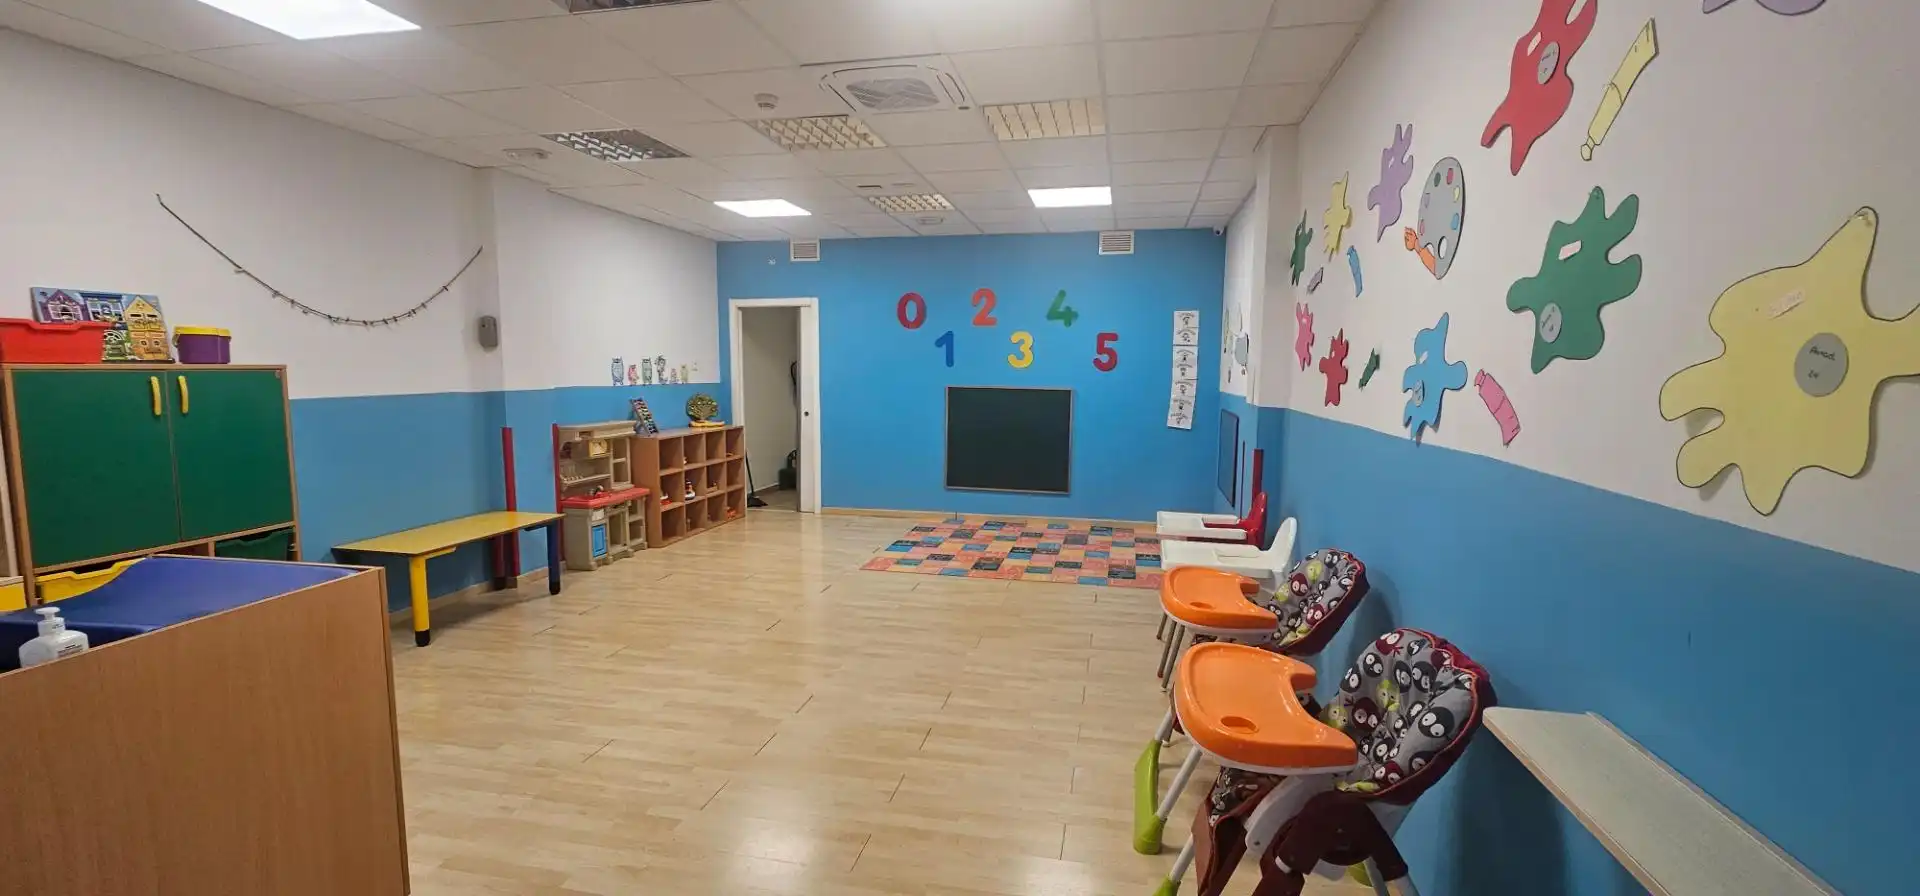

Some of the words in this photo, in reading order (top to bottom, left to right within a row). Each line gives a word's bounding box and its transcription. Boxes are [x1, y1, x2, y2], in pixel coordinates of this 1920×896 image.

[897, 292, 927, 330] 0
[971, 287, 998, 327] 2
[1046, 289, 1079, 328] 4
[935, 330, 955, 368] 1
[1007, 331, 1035, 370] 3
[1092, 332, 1119, 372] 5
